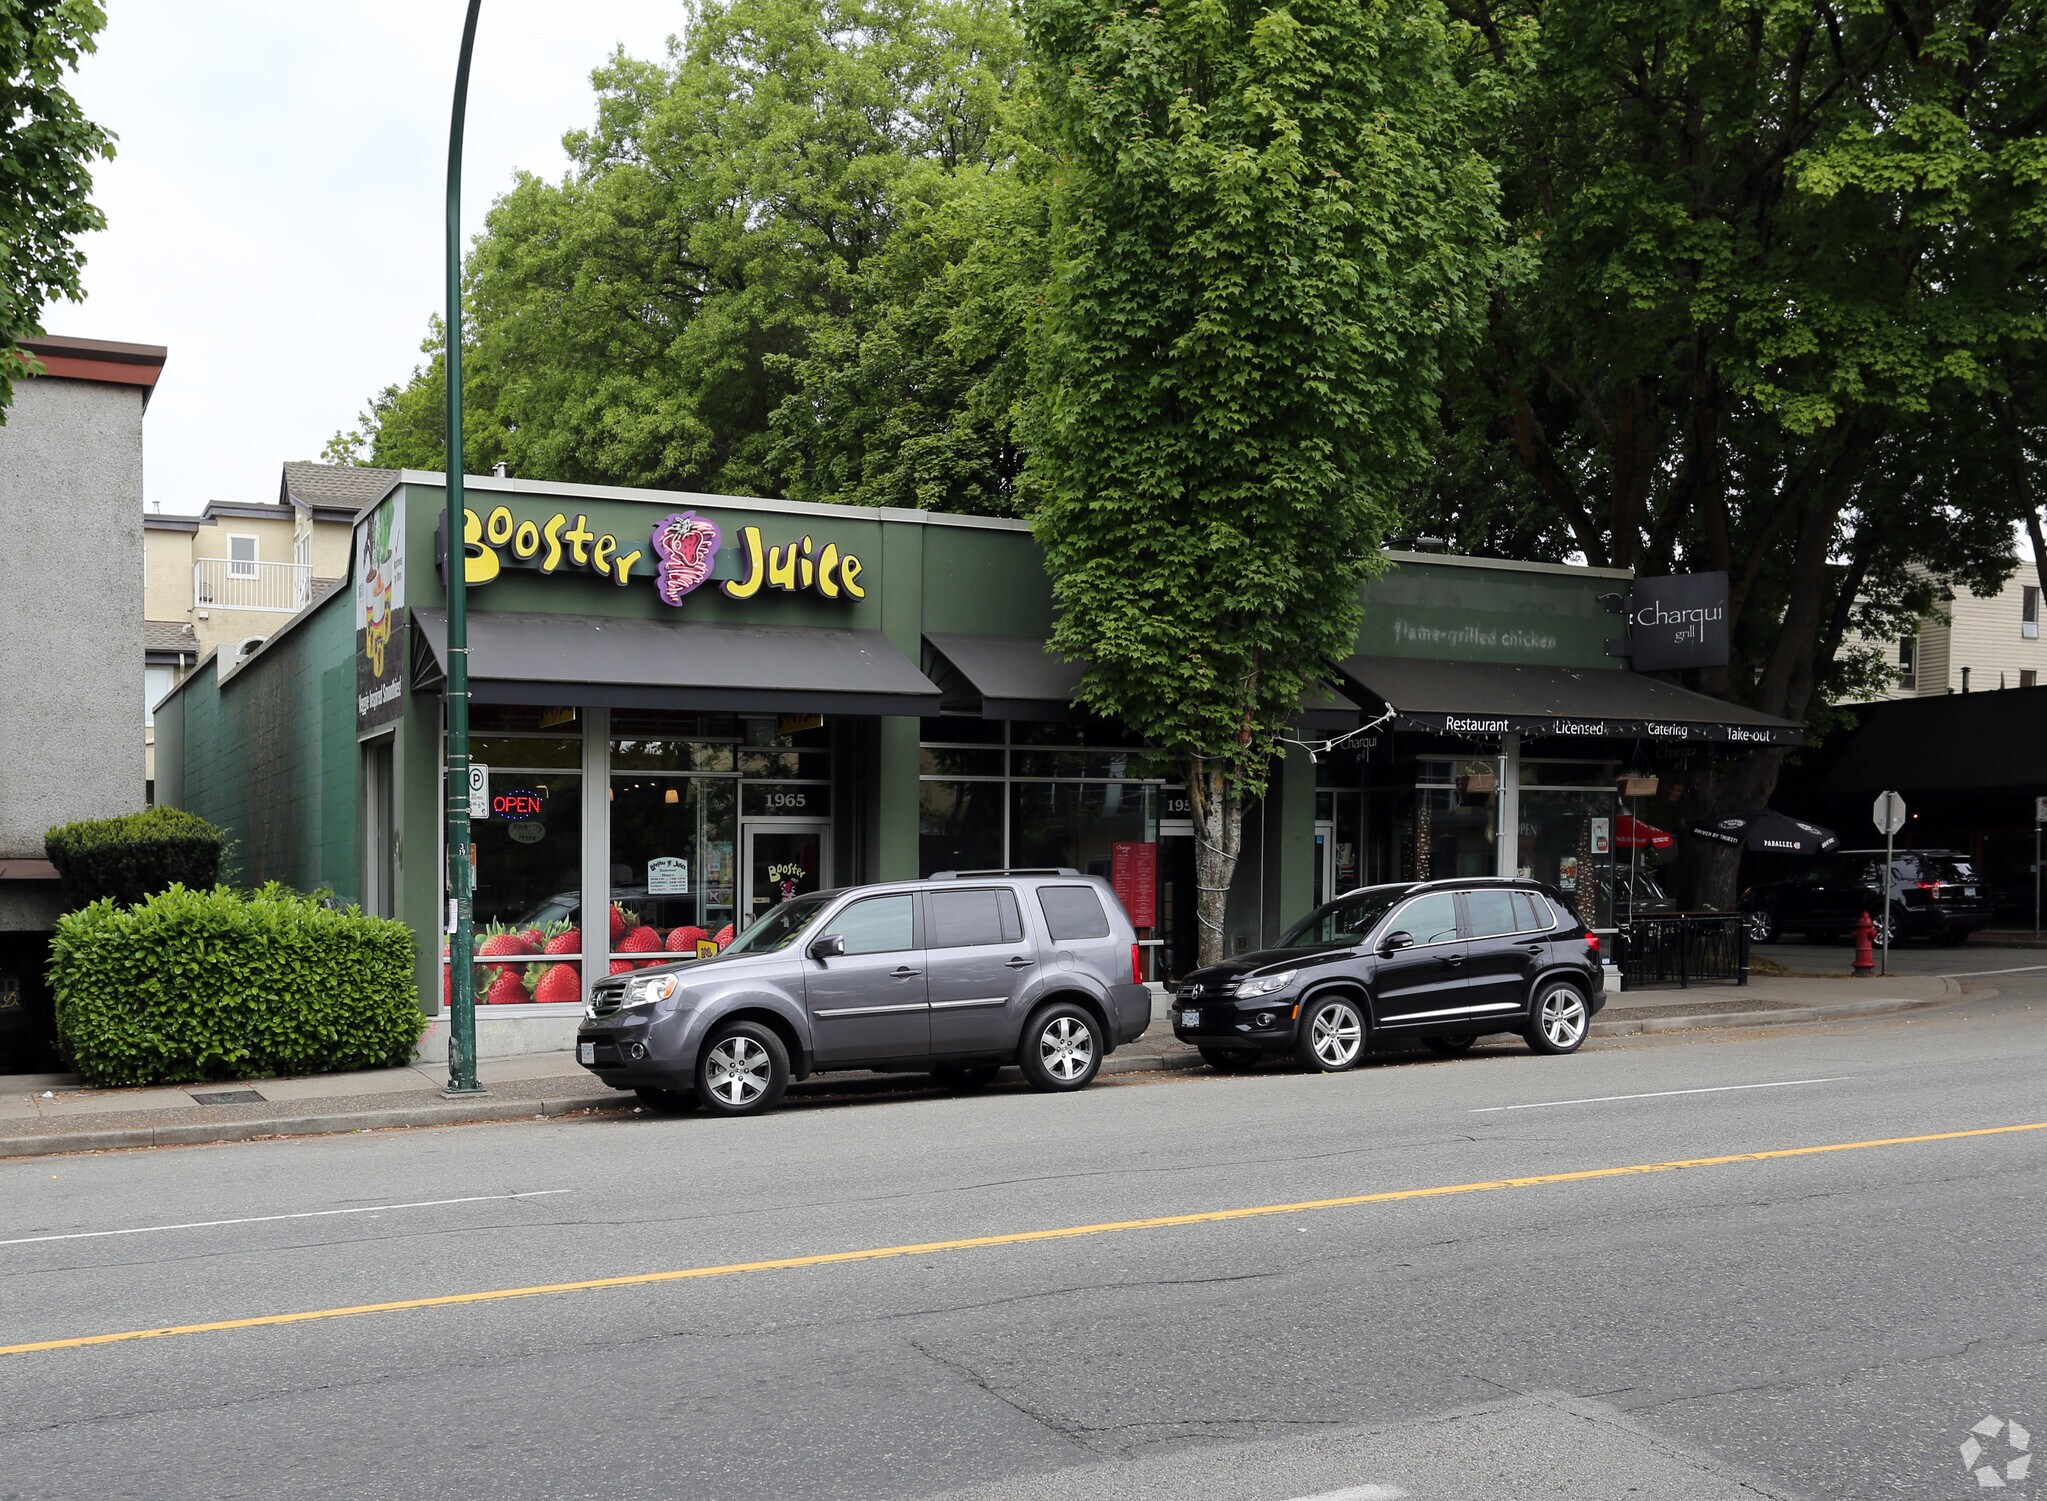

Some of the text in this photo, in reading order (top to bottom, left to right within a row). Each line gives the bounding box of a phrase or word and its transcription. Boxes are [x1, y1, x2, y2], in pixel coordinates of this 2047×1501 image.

[460, 505, 867, 602] Booster Juice
[1501, 629, 1556, 649] chicken
[1674, 624, 1695, 644] grill
[1445, 715, 1770, 742] Restaurant Licensed Catering Take-out
[473, 773, 481, 786] P
[493, 796, 541, 813] OPEN
[764, 793, 806, 808] 1965
[1517, 823, 1537, 836] PEN
[1764, 840, 1793, 848] PARALLEL
[768, 862, 806, 882] Booster
